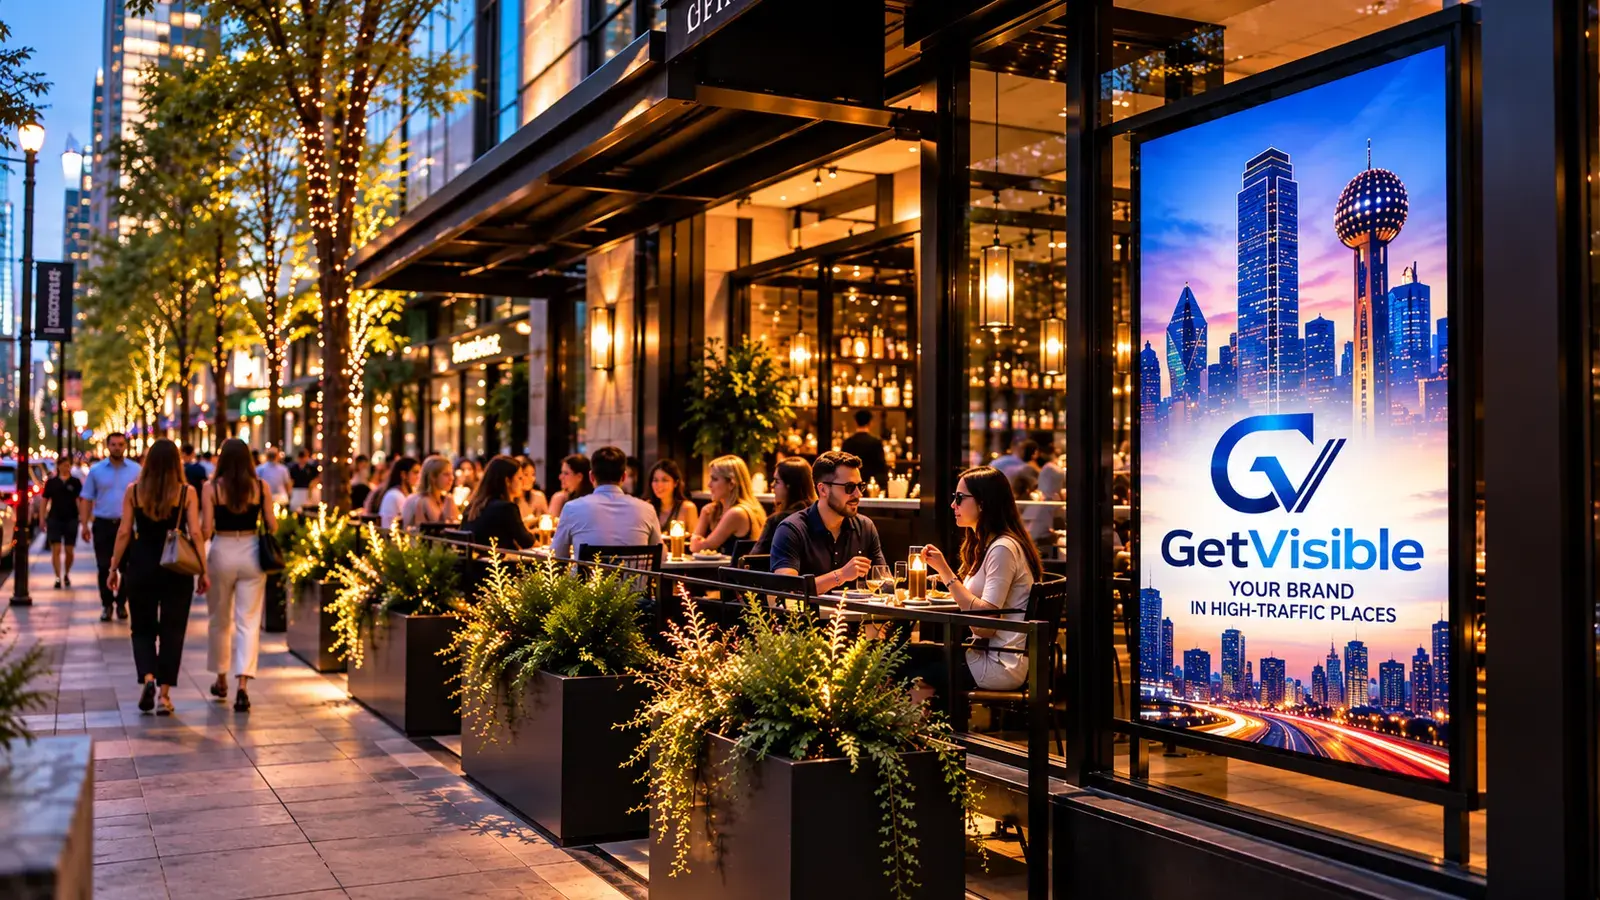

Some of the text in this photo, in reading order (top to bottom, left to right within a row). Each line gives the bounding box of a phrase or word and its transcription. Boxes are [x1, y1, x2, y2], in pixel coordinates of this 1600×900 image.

[1161, 528, 1424, 571] GetVisible
[1229, 581, 1354, 599] YOUR BRAND
[1191, 600, 1397, 623] IN HIGH-TRAFFIC PLACES
